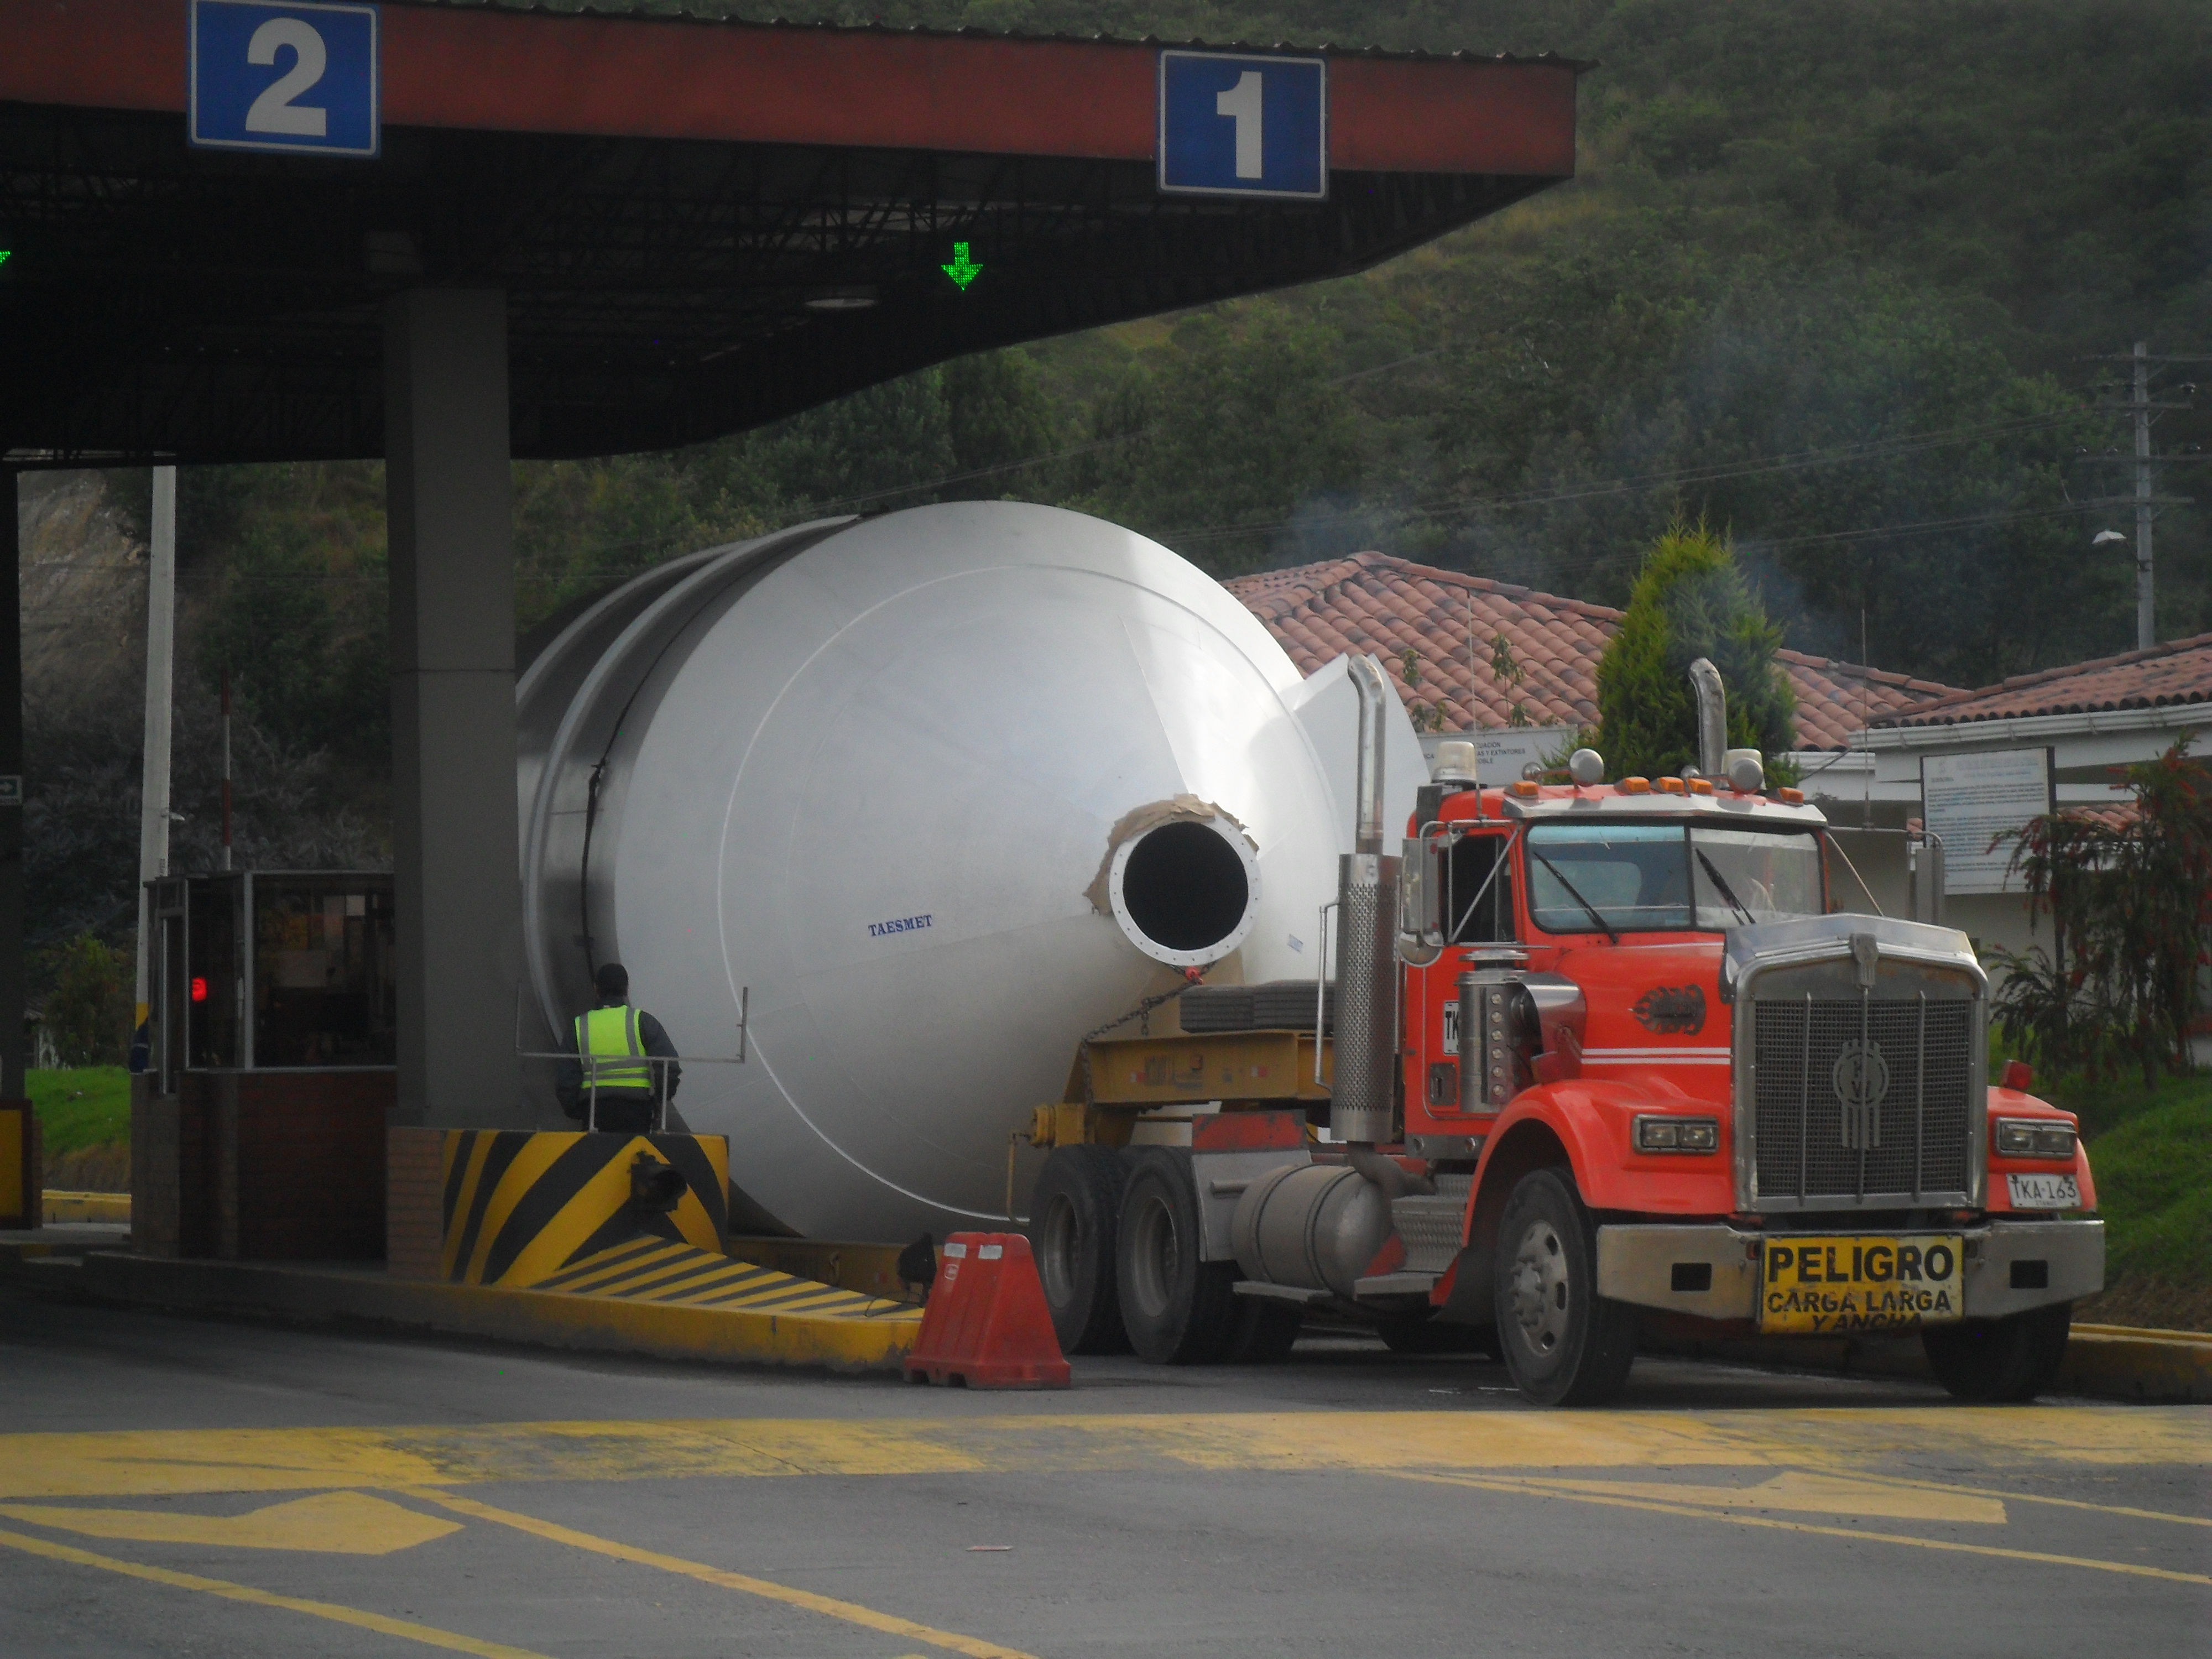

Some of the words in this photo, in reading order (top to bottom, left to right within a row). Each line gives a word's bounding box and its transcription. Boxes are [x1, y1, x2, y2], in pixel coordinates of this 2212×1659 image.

[246, 17, 326, 137] 2
[1217, 71, 1262, 179] 1
[868, 915, 932, 936] TAESMET
[1445, 1011, 1459, 1040] TK
[1769, 1245, 1954, 1282] PELIGRO
[1767, 1292, 1856, 1313] CARGA
[1865, 1290, 1952, 1312] LARGA
